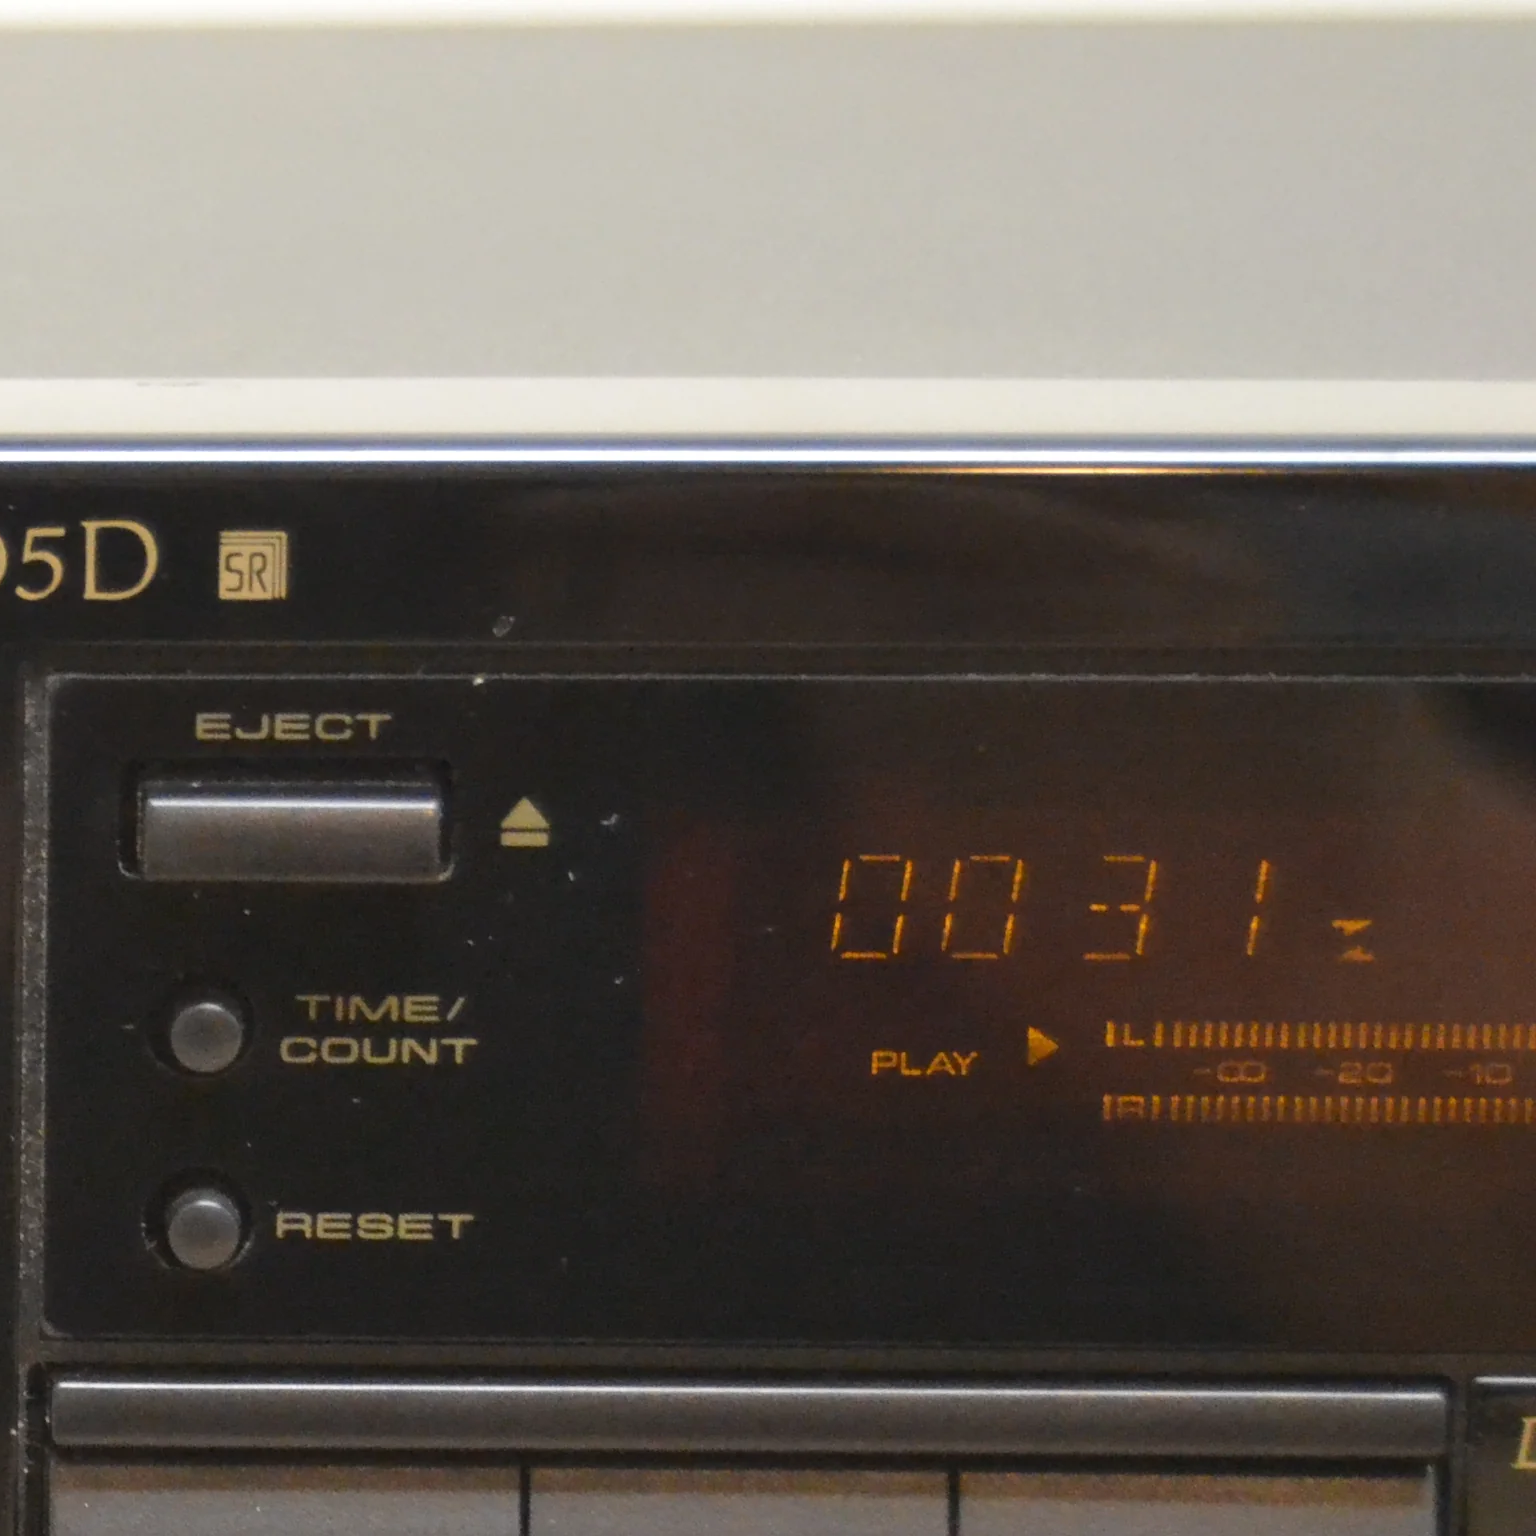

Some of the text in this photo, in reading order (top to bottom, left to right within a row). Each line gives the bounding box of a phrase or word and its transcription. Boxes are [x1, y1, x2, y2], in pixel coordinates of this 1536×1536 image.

[195, 712, 392, 741] EJECT
[297, 994, 465, 1023] TIME/
[280, 1036, 478, 1065] COUNT
[870, 1049, 978, 1077] PLAY
[275, 1211, 474, 1241] RESET
